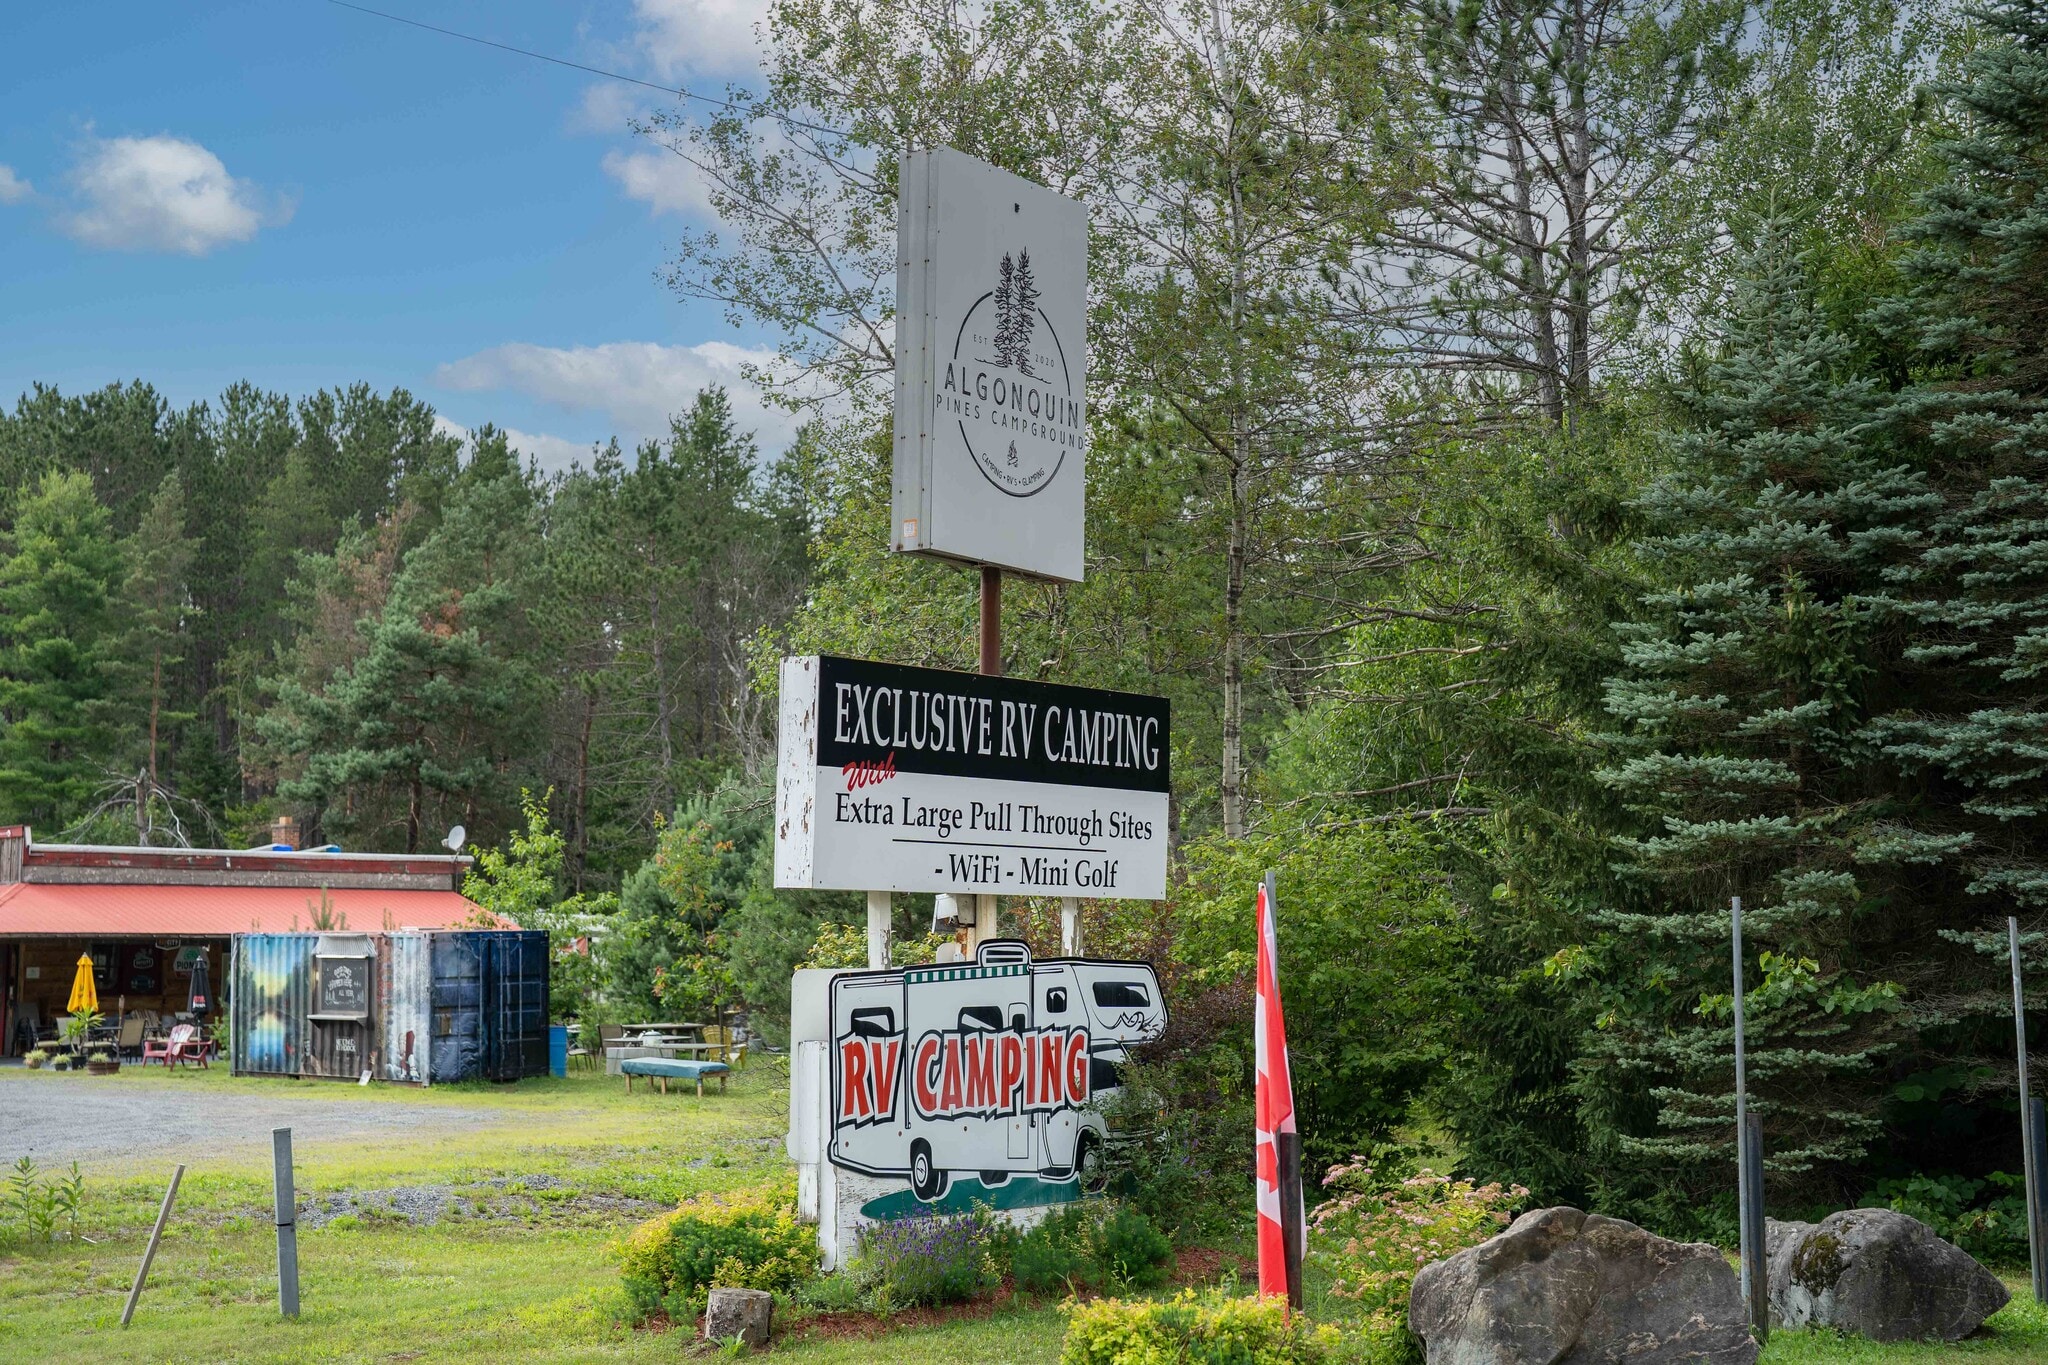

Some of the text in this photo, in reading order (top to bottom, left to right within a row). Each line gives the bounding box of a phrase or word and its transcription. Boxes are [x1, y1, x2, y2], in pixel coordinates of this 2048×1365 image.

[973, 333, 1055, 368] EST 2020
[936, 393, 1083, 450] PINES CAMPGROUND
[944, 362, 1078, 429] ALGONQUIN
[981, 452, 1003, 480] CAMPING
[1021, 467, 1045, 487] GLAMPING
[834, 682, 1160, 771] EXCLUSIVE RV CAMPING
[842, 751, 897, 792] With
[835, 792, 1152, 846] Extra Large Pull Through Sites
[949, 853, 1000, 884] WiFi
[1020, 857, 1069, 887] Mini
[1074, 859, 1119, 889] Golf
[841, 1031, 1089, 1121] RV CAMPING
